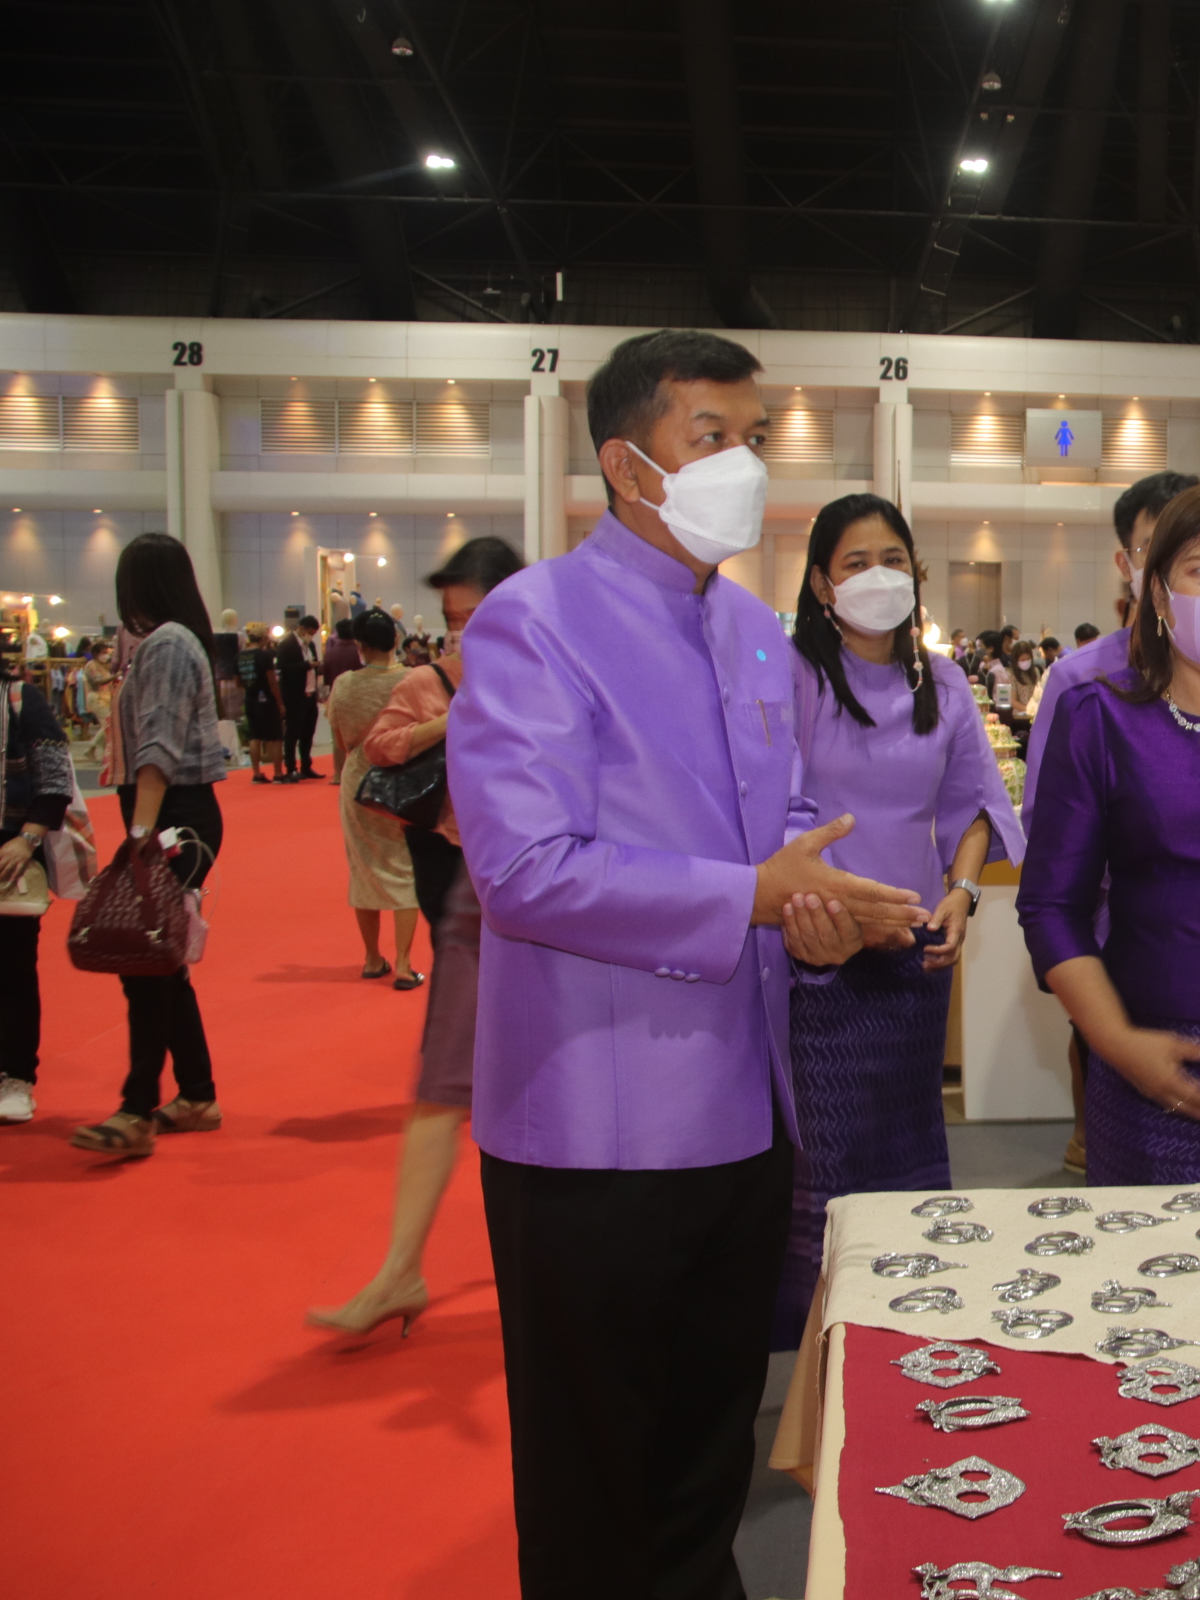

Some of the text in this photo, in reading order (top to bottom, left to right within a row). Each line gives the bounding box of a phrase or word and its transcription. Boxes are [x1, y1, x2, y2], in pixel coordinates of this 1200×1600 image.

[172, 341, 204, 367] 28
[531, 348, 559, 373] 27
[879, 356, 909, 381] 26
